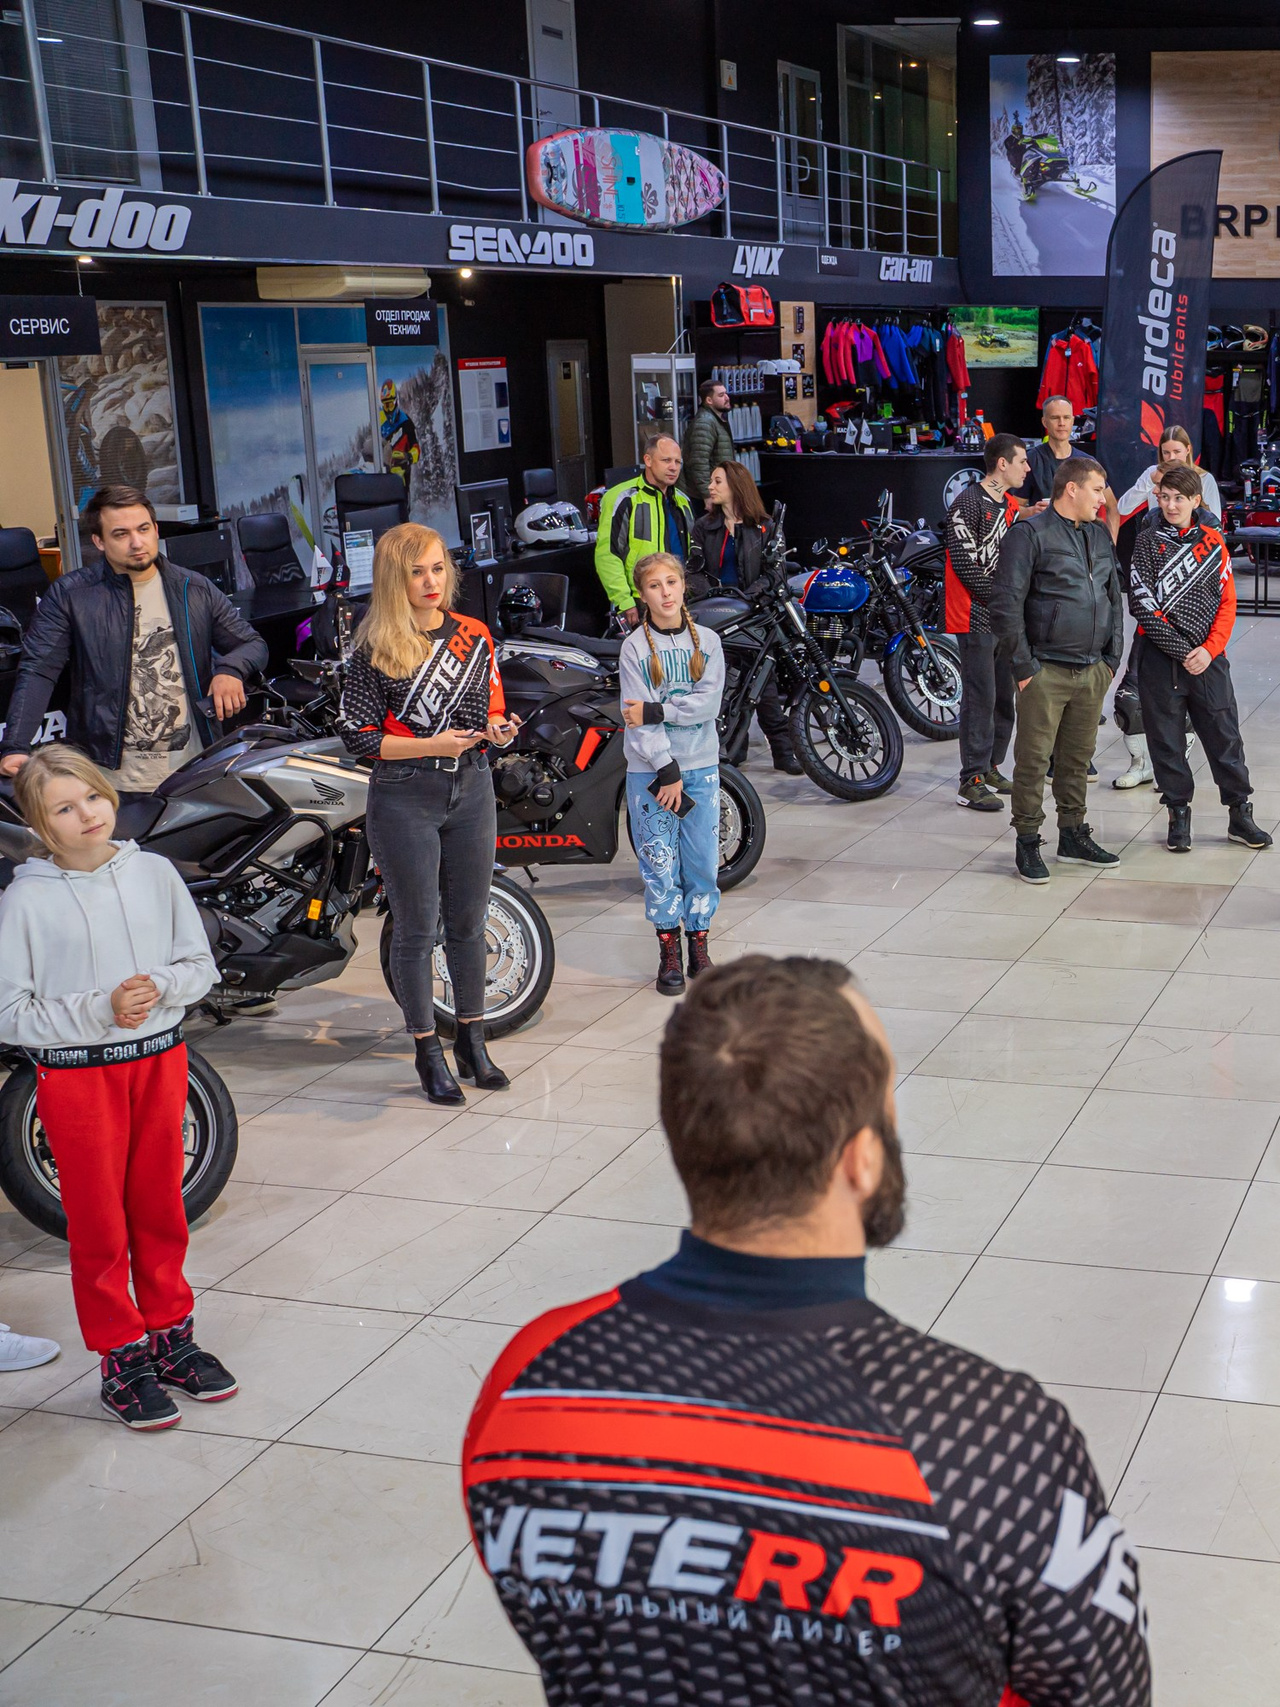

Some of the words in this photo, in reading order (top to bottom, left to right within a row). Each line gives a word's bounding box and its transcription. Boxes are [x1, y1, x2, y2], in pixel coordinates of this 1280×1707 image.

[1180, 204, 1268, 239] BRP
[732, 245, 784, 278] LYNX
[9, 317, 70, 335] СЕРВИС
[375, 309, 400, 322] ОТДЕЛ
[400, 310, 431, 322] ПРОДАЖ
[1138, 228, 1177, 396] ardeca
[388, 324, 421, 335] ТЕХНИКИ
[1169, 294, 1189, 400] lubricants
[409, 623, 482, 728] VETERR
[667, 894, 682, 915] KIND
[47, 1050, 89, 1065] DOWN
[103, 1047, 141, 1061] COOL
[143, 1031, 174, 1055] DOWN
[483, 1504, 925, 1629] VETERR
[1041, 1488, 1148, 1626] VE
